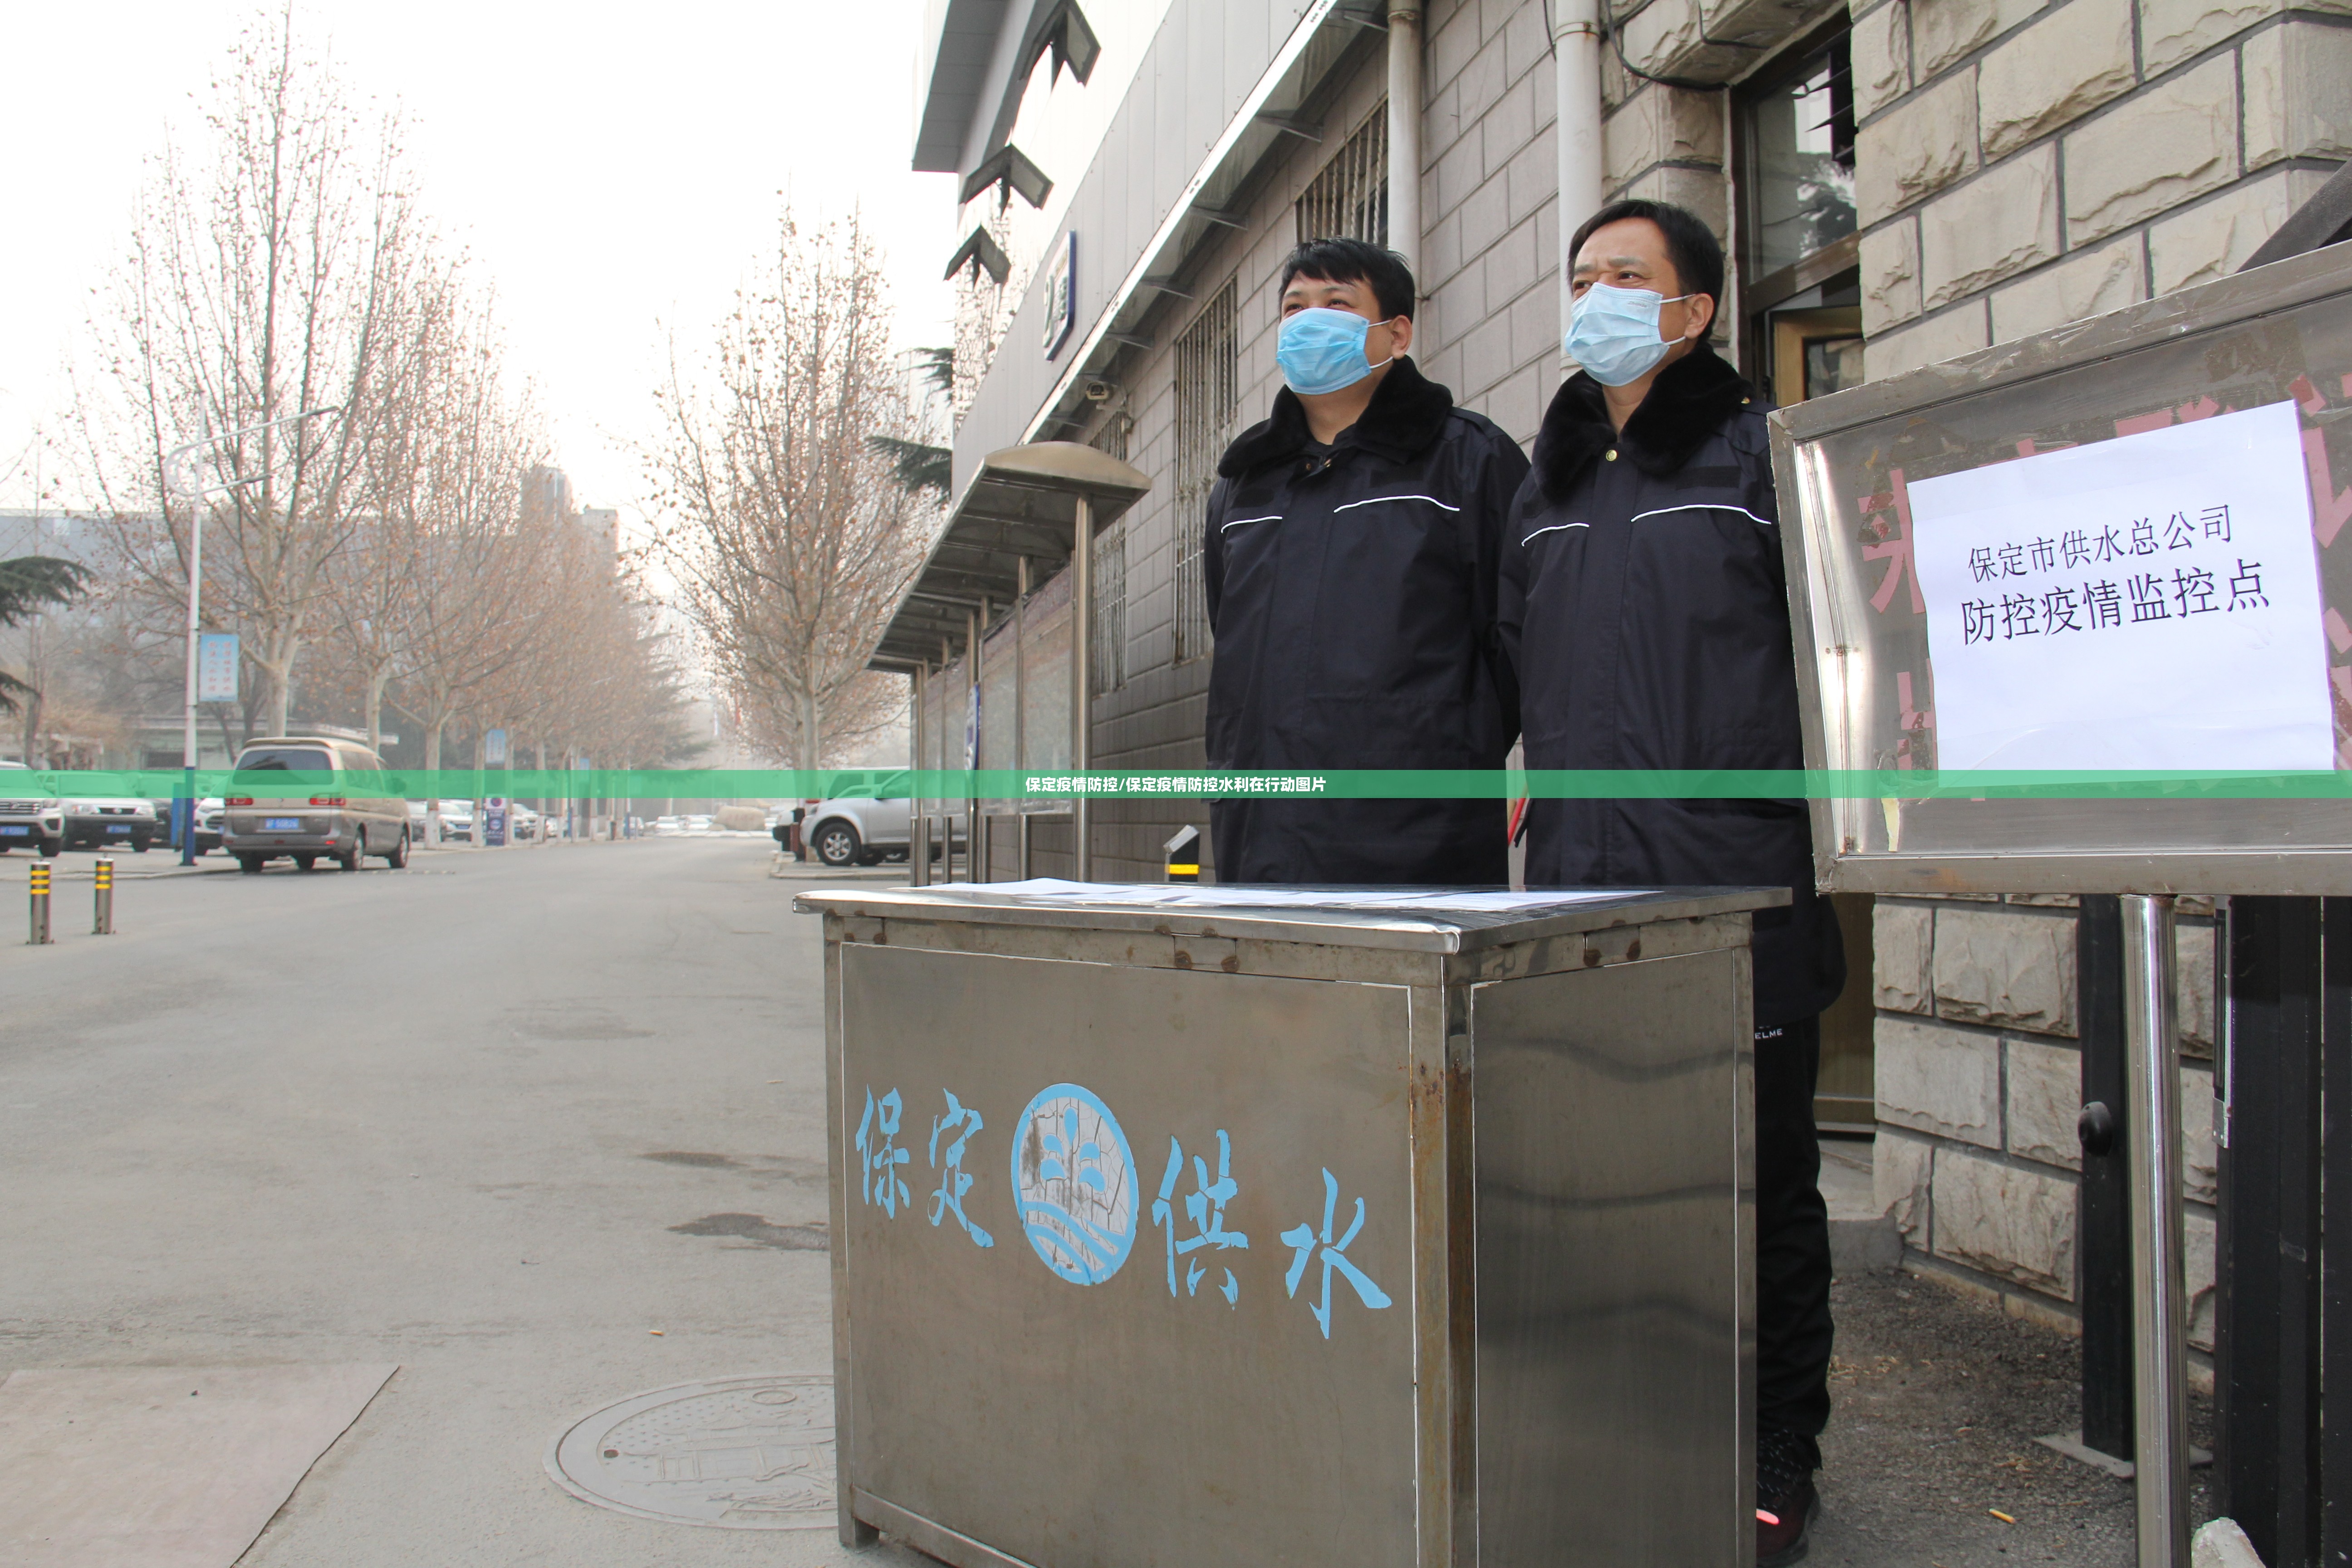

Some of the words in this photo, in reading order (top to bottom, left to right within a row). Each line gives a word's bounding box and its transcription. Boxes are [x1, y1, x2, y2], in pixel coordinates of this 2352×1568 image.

[1968, 504, 2231, 583] 保定市供水总公司
[1960, 558, 2270, 645] 防控疫情监控点
[856, 1084, 993, 1247] 保定
[1152, 1129, 1392, 1339] 供水
